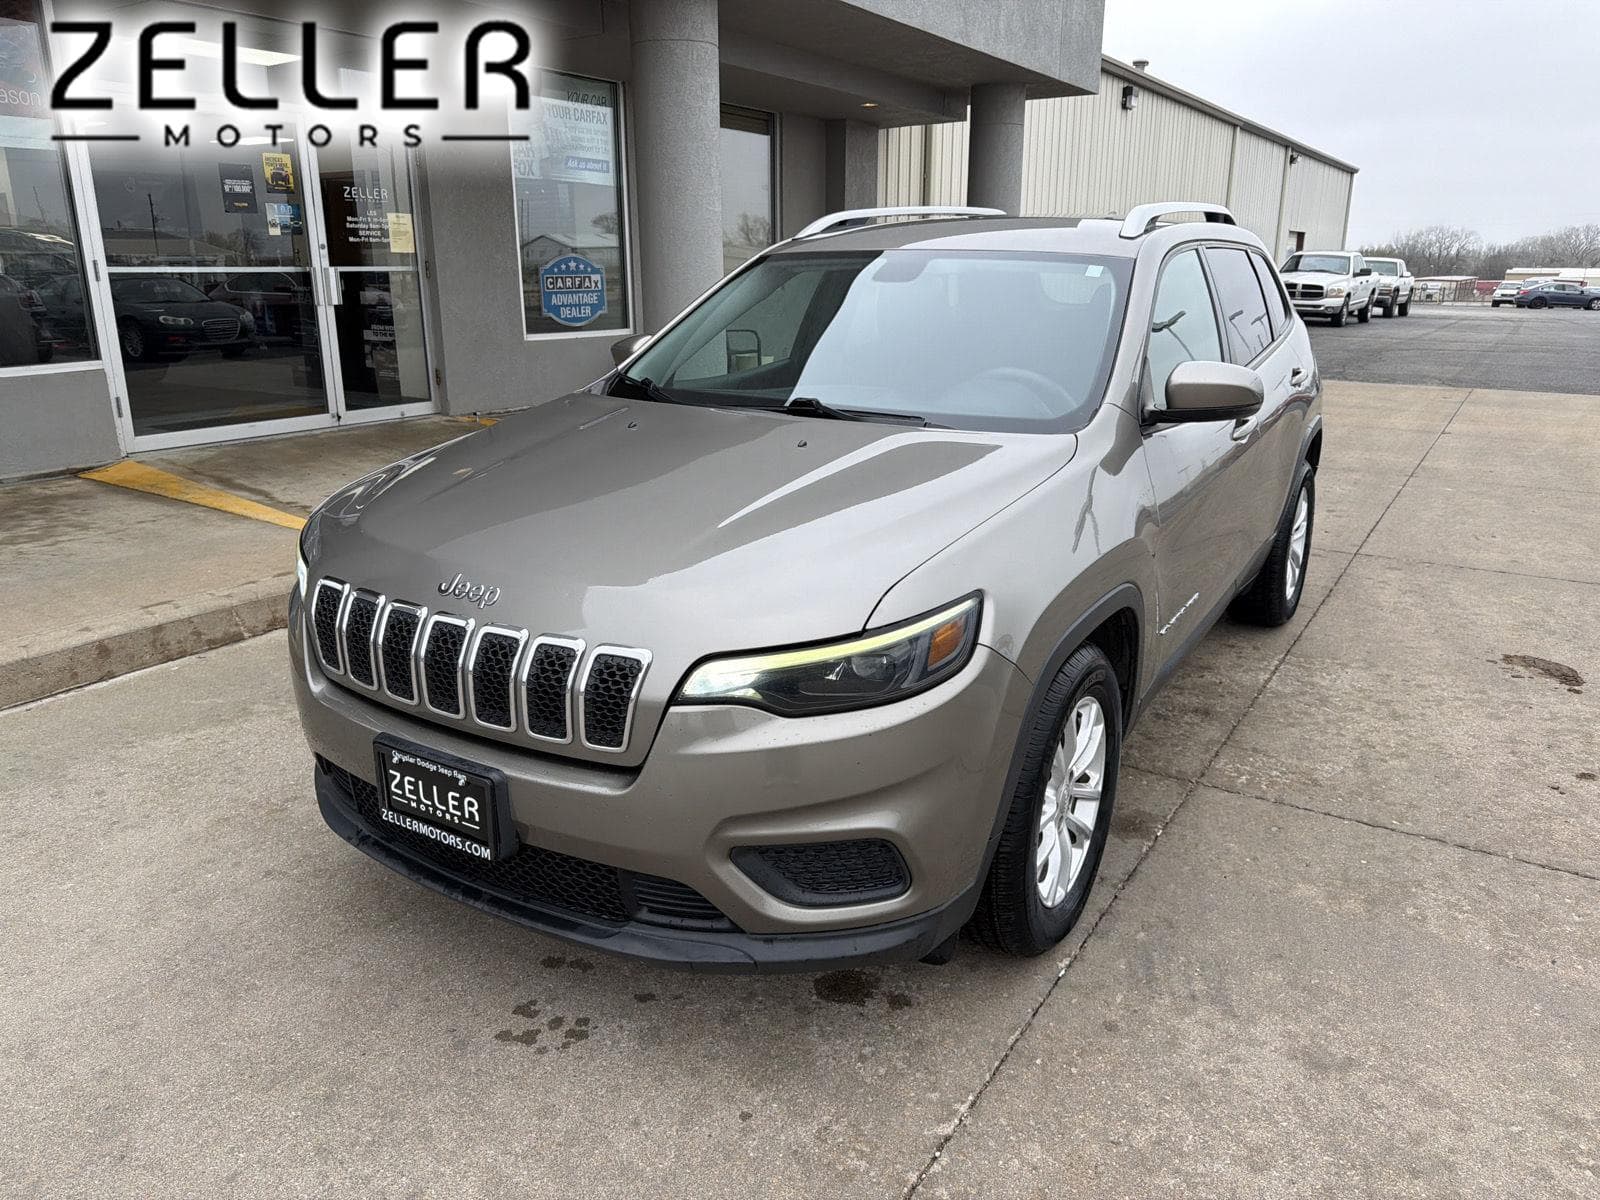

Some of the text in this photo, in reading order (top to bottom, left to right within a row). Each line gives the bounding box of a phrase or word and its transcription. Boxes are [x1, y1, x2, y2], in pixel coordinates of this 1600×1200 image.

[546, 103, 608, 125] YOUR CARFAX
[343, 186, 388, 199] ZELLER
[546, 276, 600, 290] CARFAX
[551, 292, 599, 306] ADVANTAGE
[560, 305, 592, 319] DEALER
[437, 573, 501, 609] Jeep
[416, 758, 437, 772] Dodge
[438, 765, 453, 778] Jeep
[389, 769, 480, 822] ZELLER
[410, 800, 460, 824] MOTORS
[382, 808, 491, 861] ZELLERMOTORS.COM
